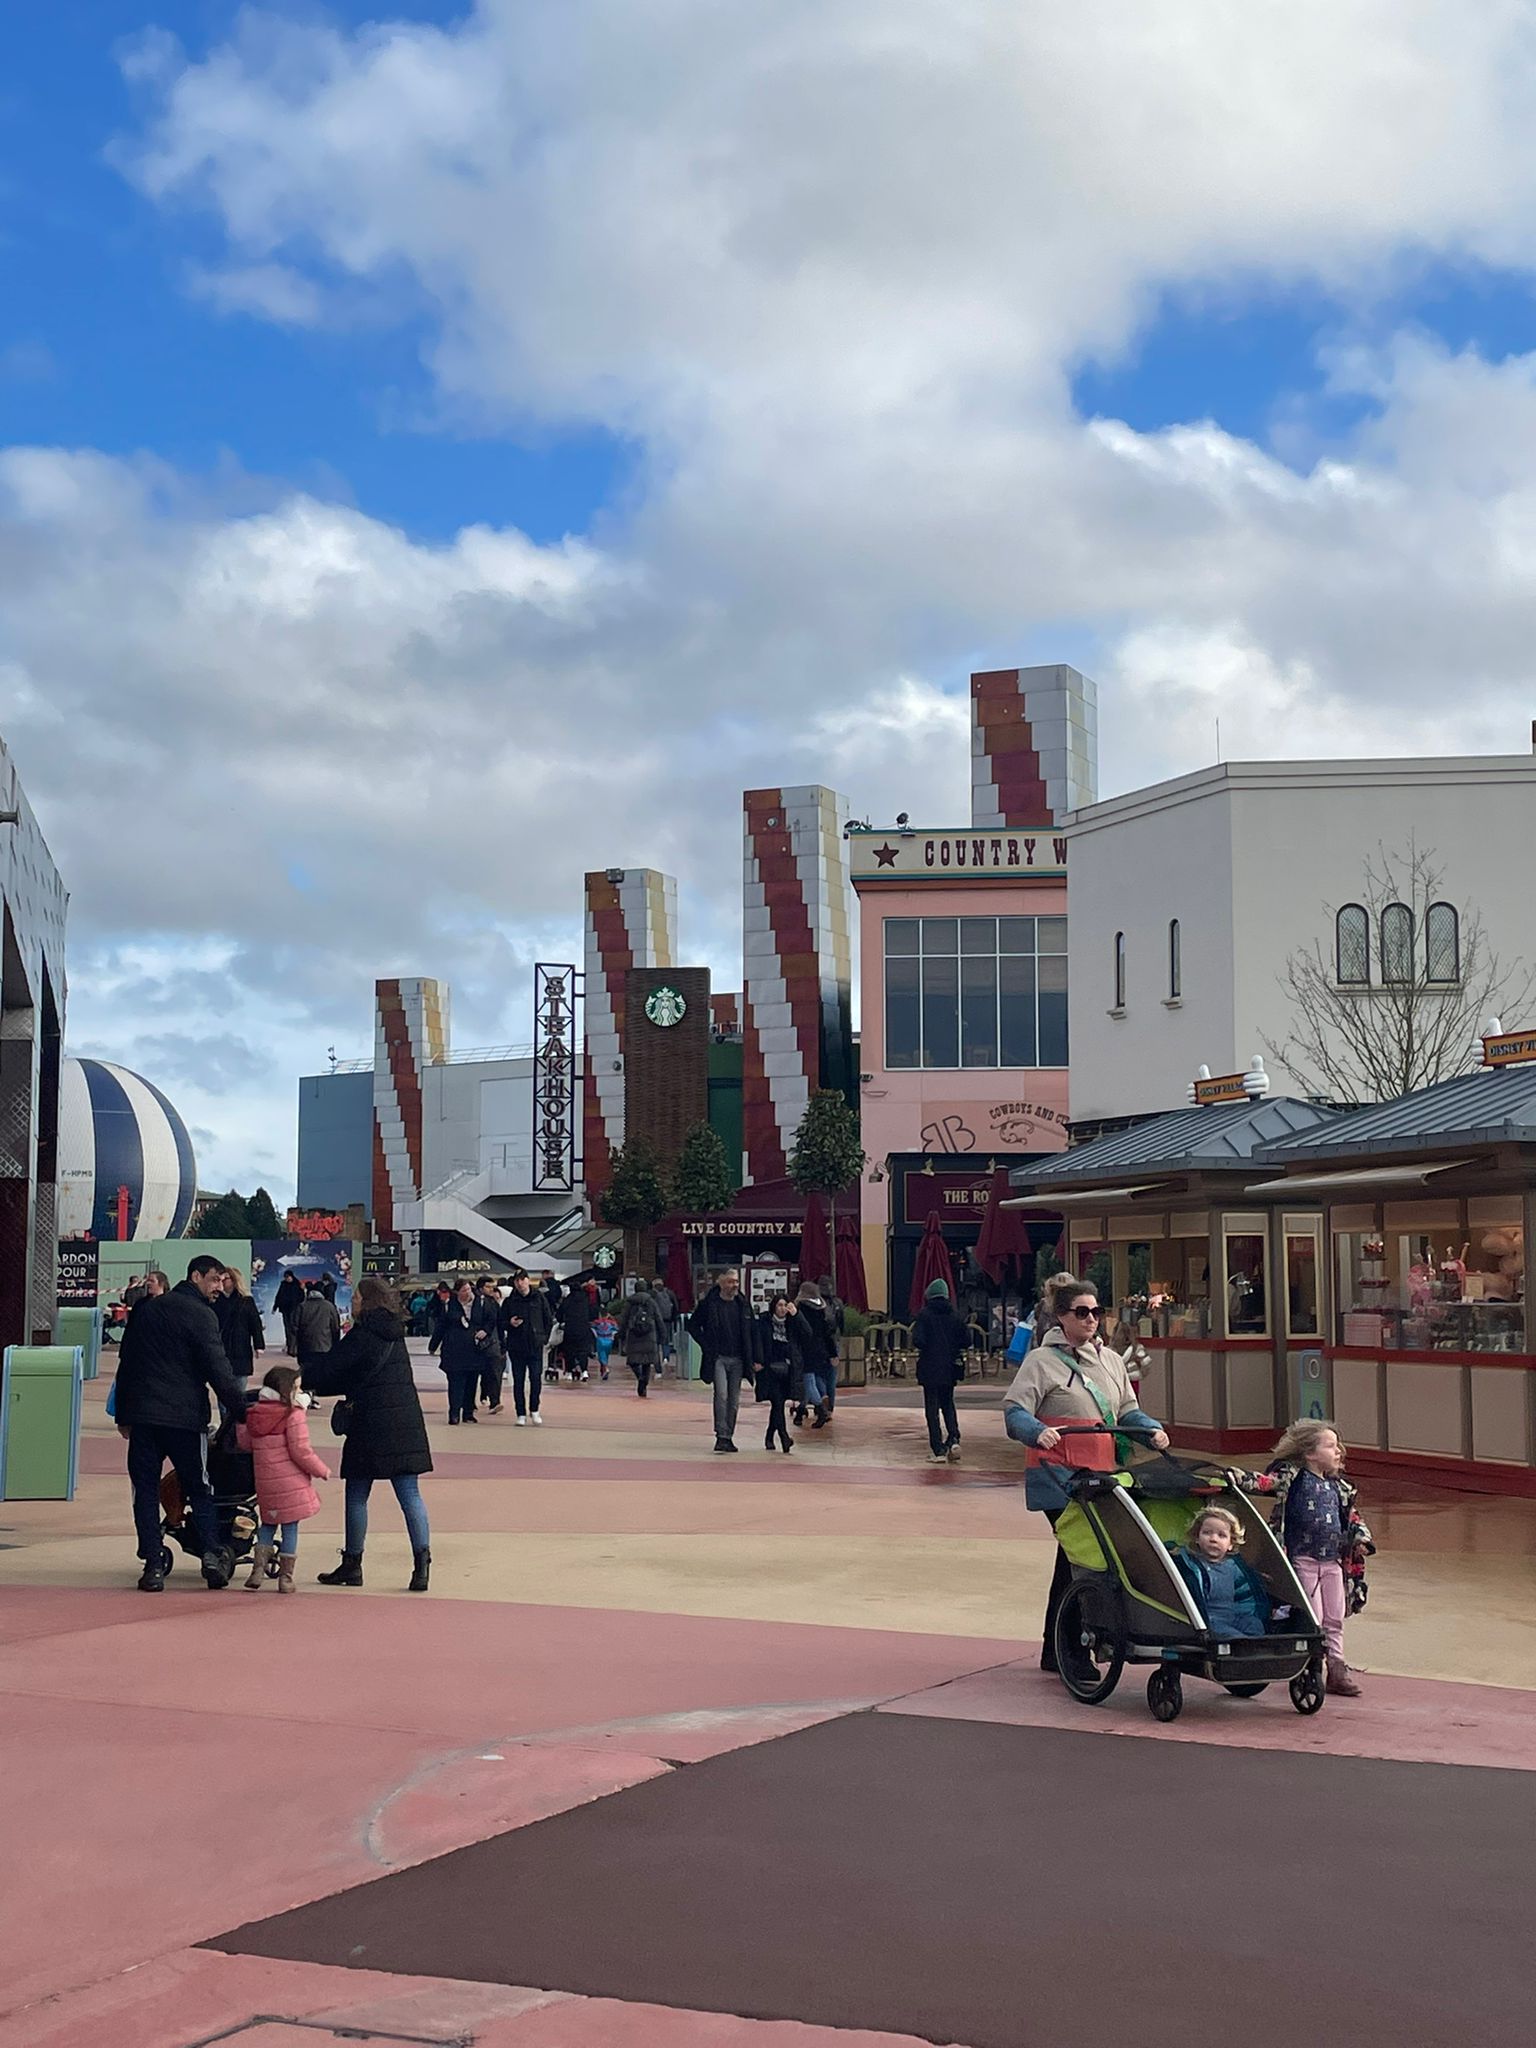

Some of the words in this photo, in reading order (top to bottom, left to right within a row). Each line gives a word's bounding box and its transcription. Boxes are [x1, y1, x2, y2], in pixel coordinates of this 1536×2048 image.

[925, 838, 1036, 867] COUNTRY
[1489, 1042, 1523, 1057] DISNEY
[544, 976, 566, 1179] STEAKHOUSE
[989, 1103, 1032, 1120] COWBOYS
[1034, 1106, 1055, 1121] AND
[943, 1190, 969, 1204] THE
[972, 1190, 992, 1204] RO
[682, 1223, 715, 1234] LIVE
[719, 1223, 784, 1234] COUNTRY
